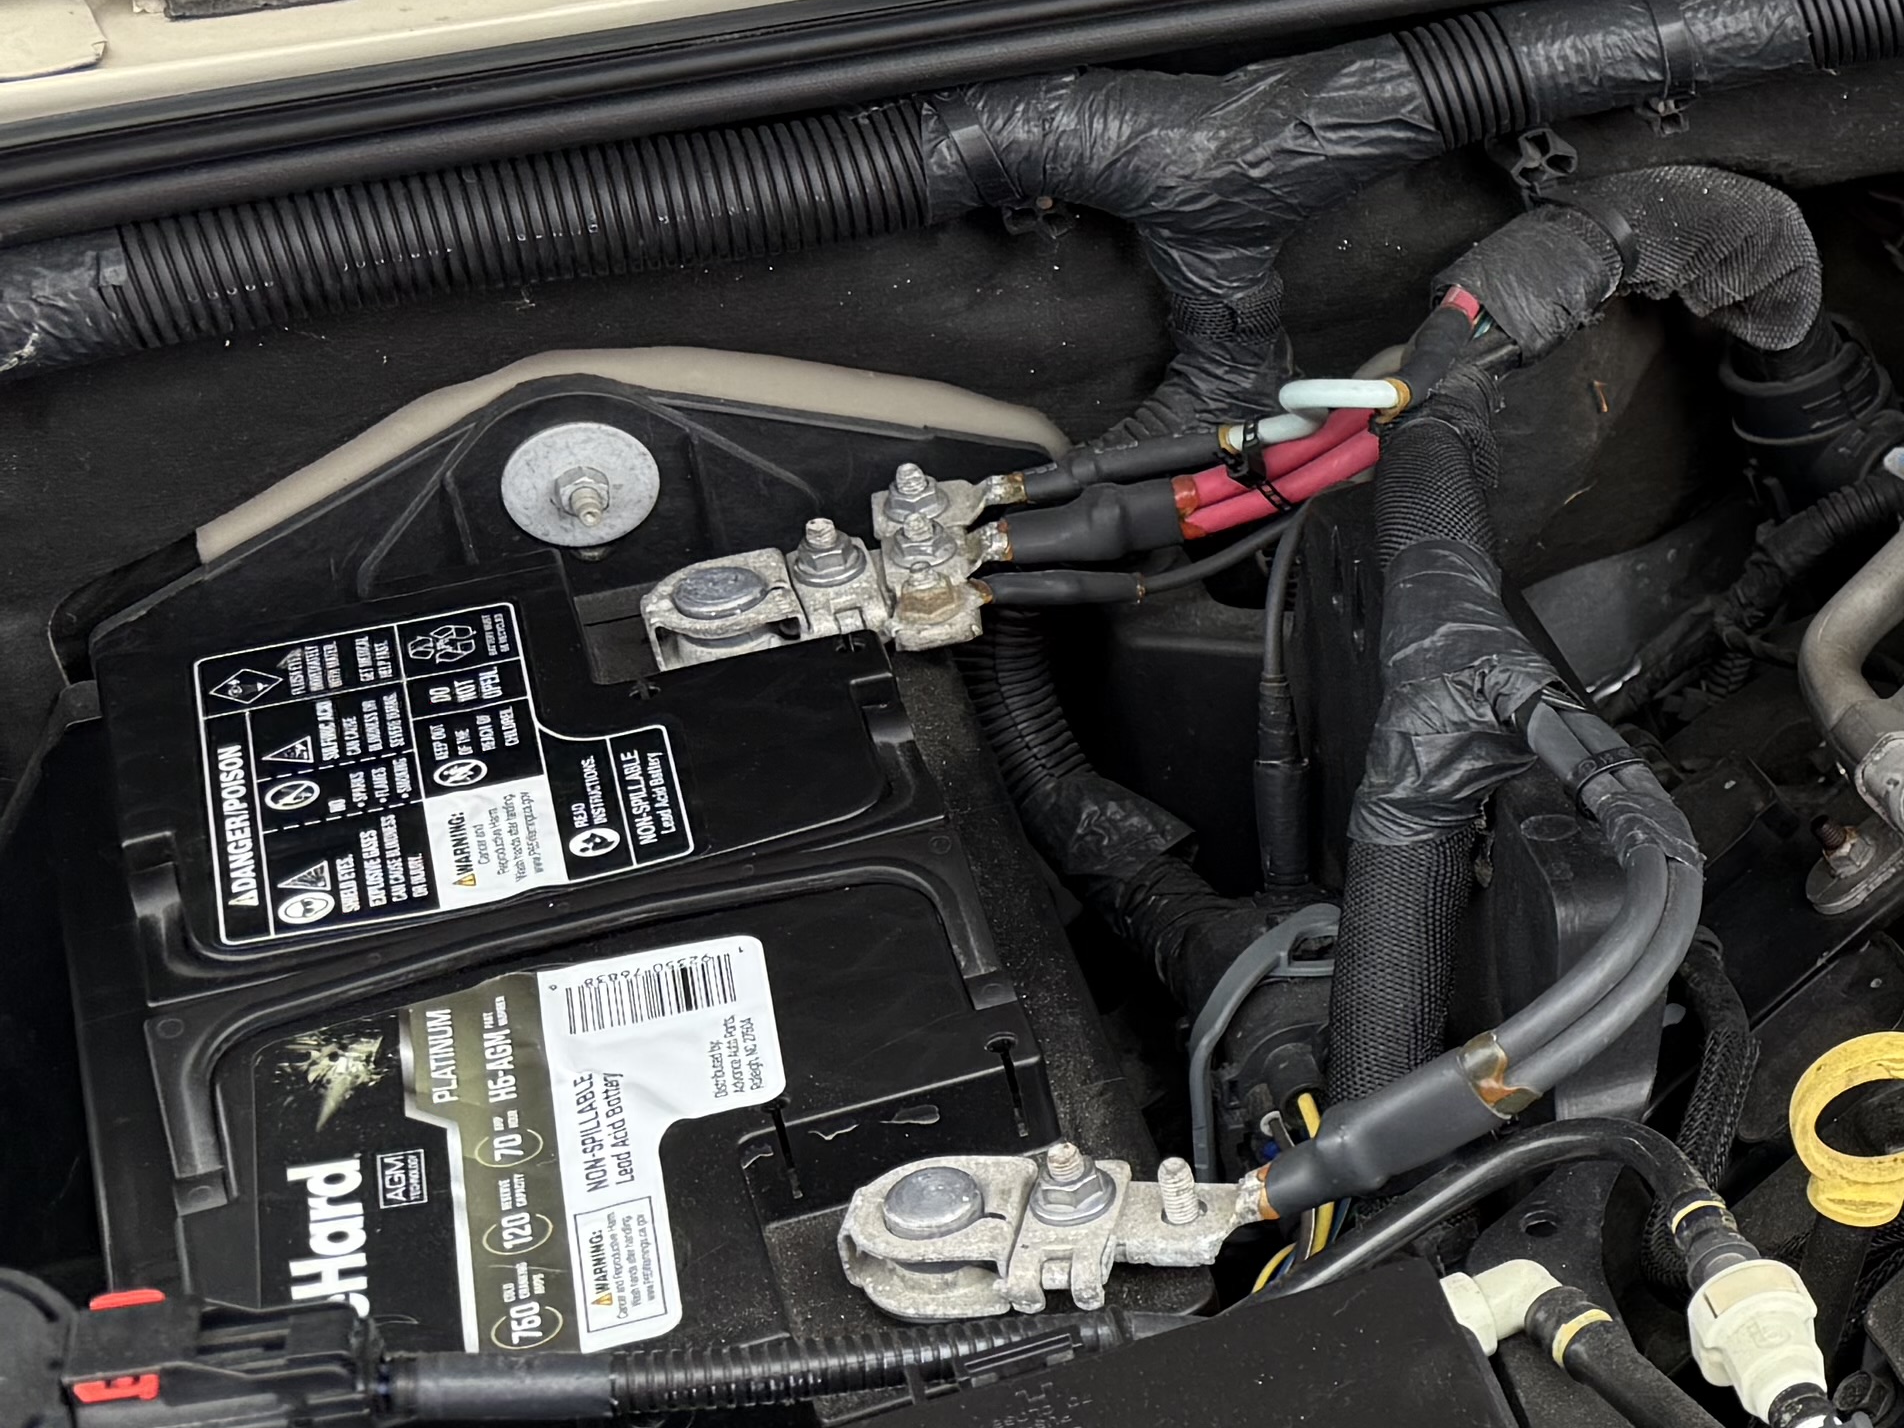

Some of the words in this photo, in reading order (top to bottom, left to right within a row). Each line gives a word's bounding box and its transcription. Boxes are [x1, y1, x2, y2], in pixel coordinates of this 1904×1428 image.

[217, 744, 258, 894] DANGER/POISON
[620, 749, 658, 845] NON-SPILLABLE
[447, 811, 472, 876] WARNING:
[426, 1009, 458, 1104] PLATINUM
[484, 1029, 517, 1103] H6-AGM
[603, 1073, 624, 1117] Battery
[494, 1133, 523, 1161] 70
[573, 1073, 609, 1192] NON-SPILLABLE
[607, 1118, 630, 1149] Acid
[384, 1155, 406, 1202] AGM
[615, 1151, 635, 1185] Lead
[502, 1212, 533, 1249] 120
[589, 1229, 610, 1294] WARNING:
[510, 1301, 543, 1344] 760
